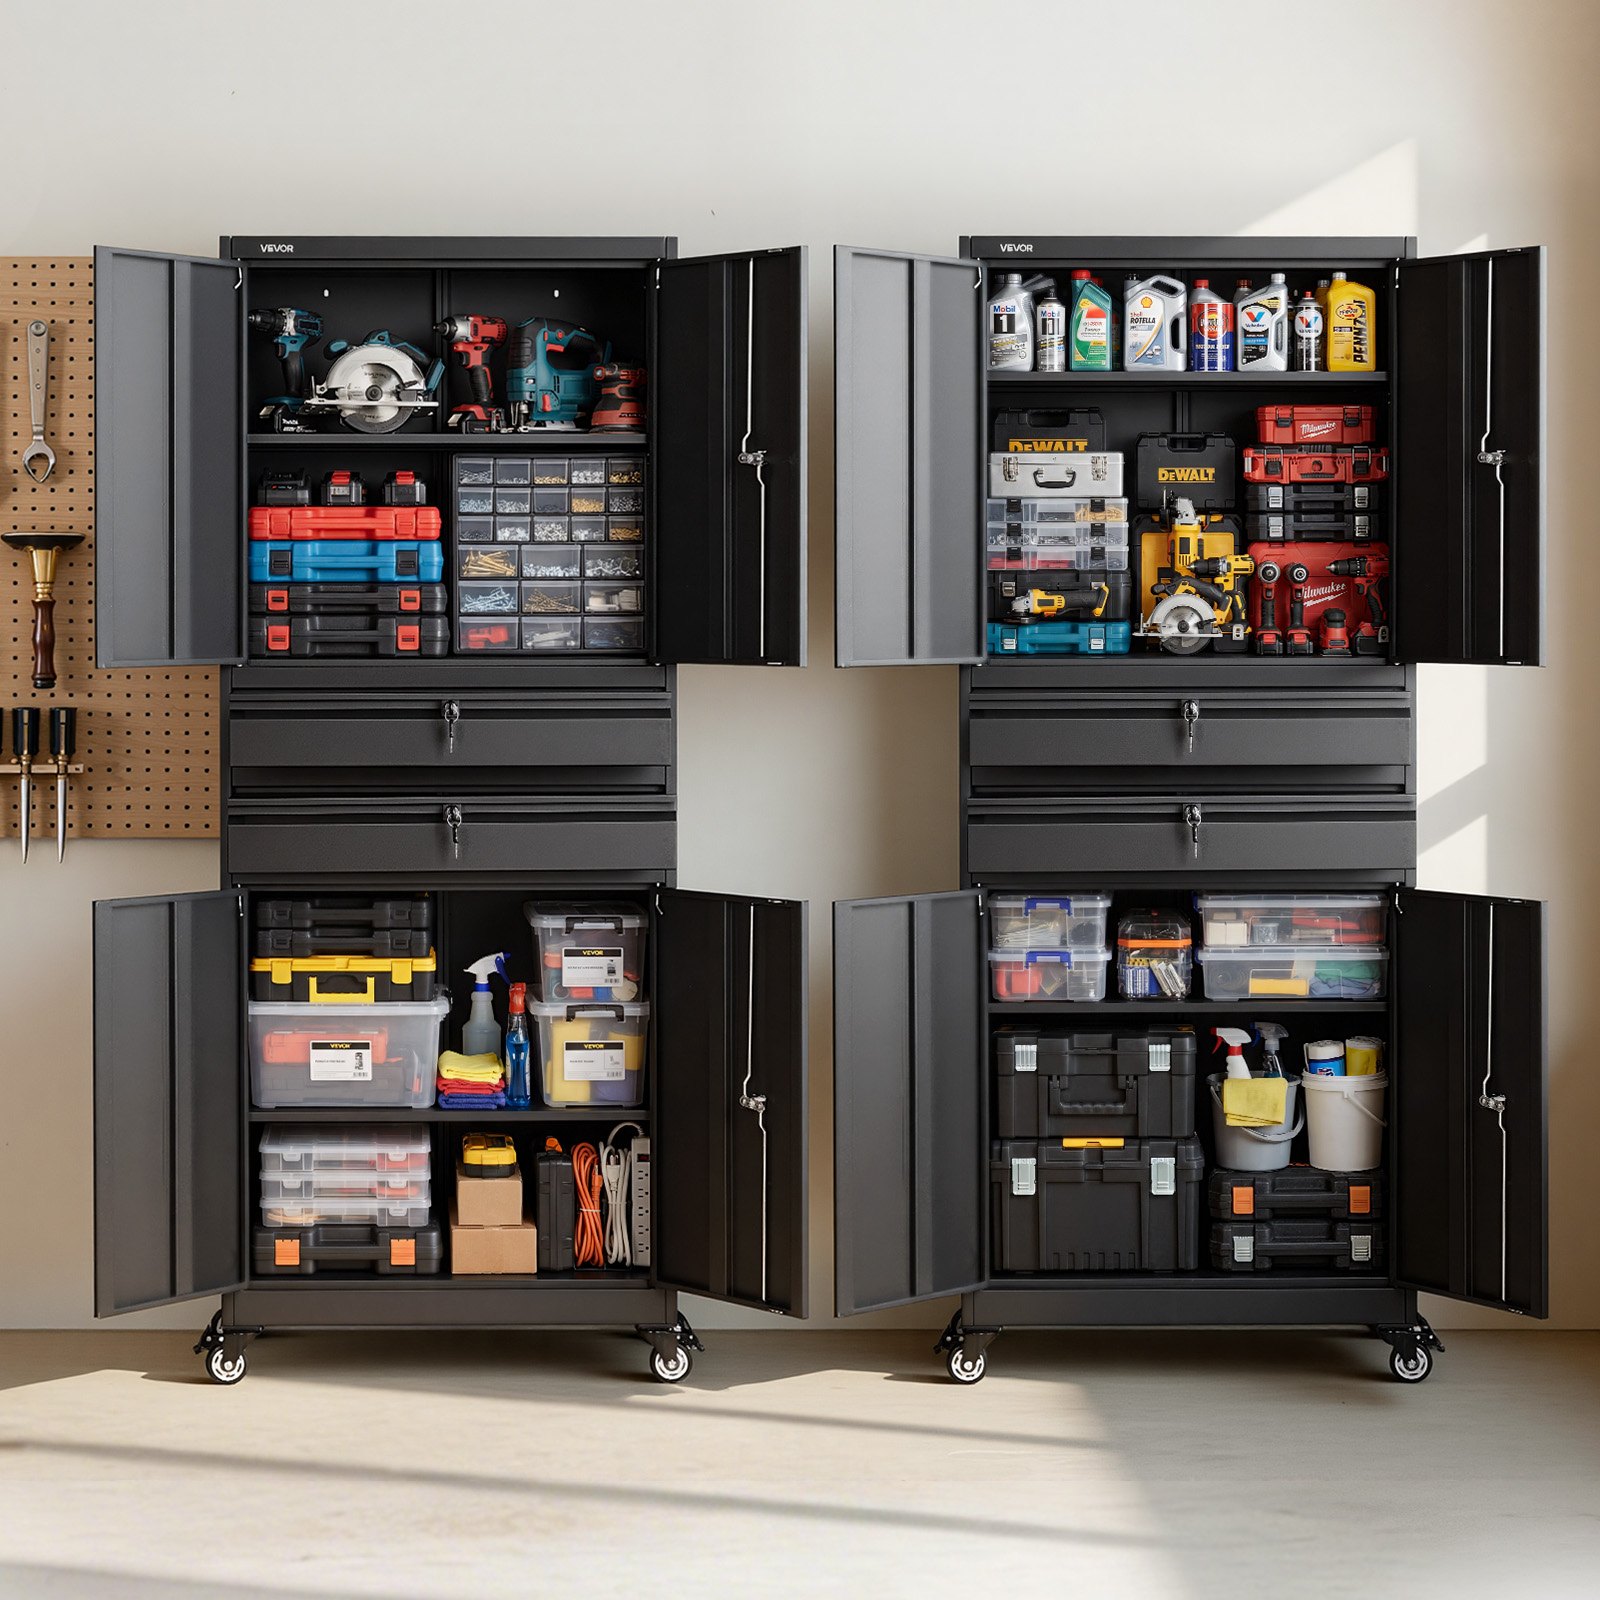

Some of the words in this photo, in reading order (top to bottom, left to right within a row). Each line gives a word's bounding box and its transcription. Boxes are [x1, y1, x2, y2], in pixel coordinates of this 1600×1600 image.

[260, 244, 294, 252] VEVOR
[1000, 244, 1033, 252] VEVOR
[999, 314, 1008, 332] 1
